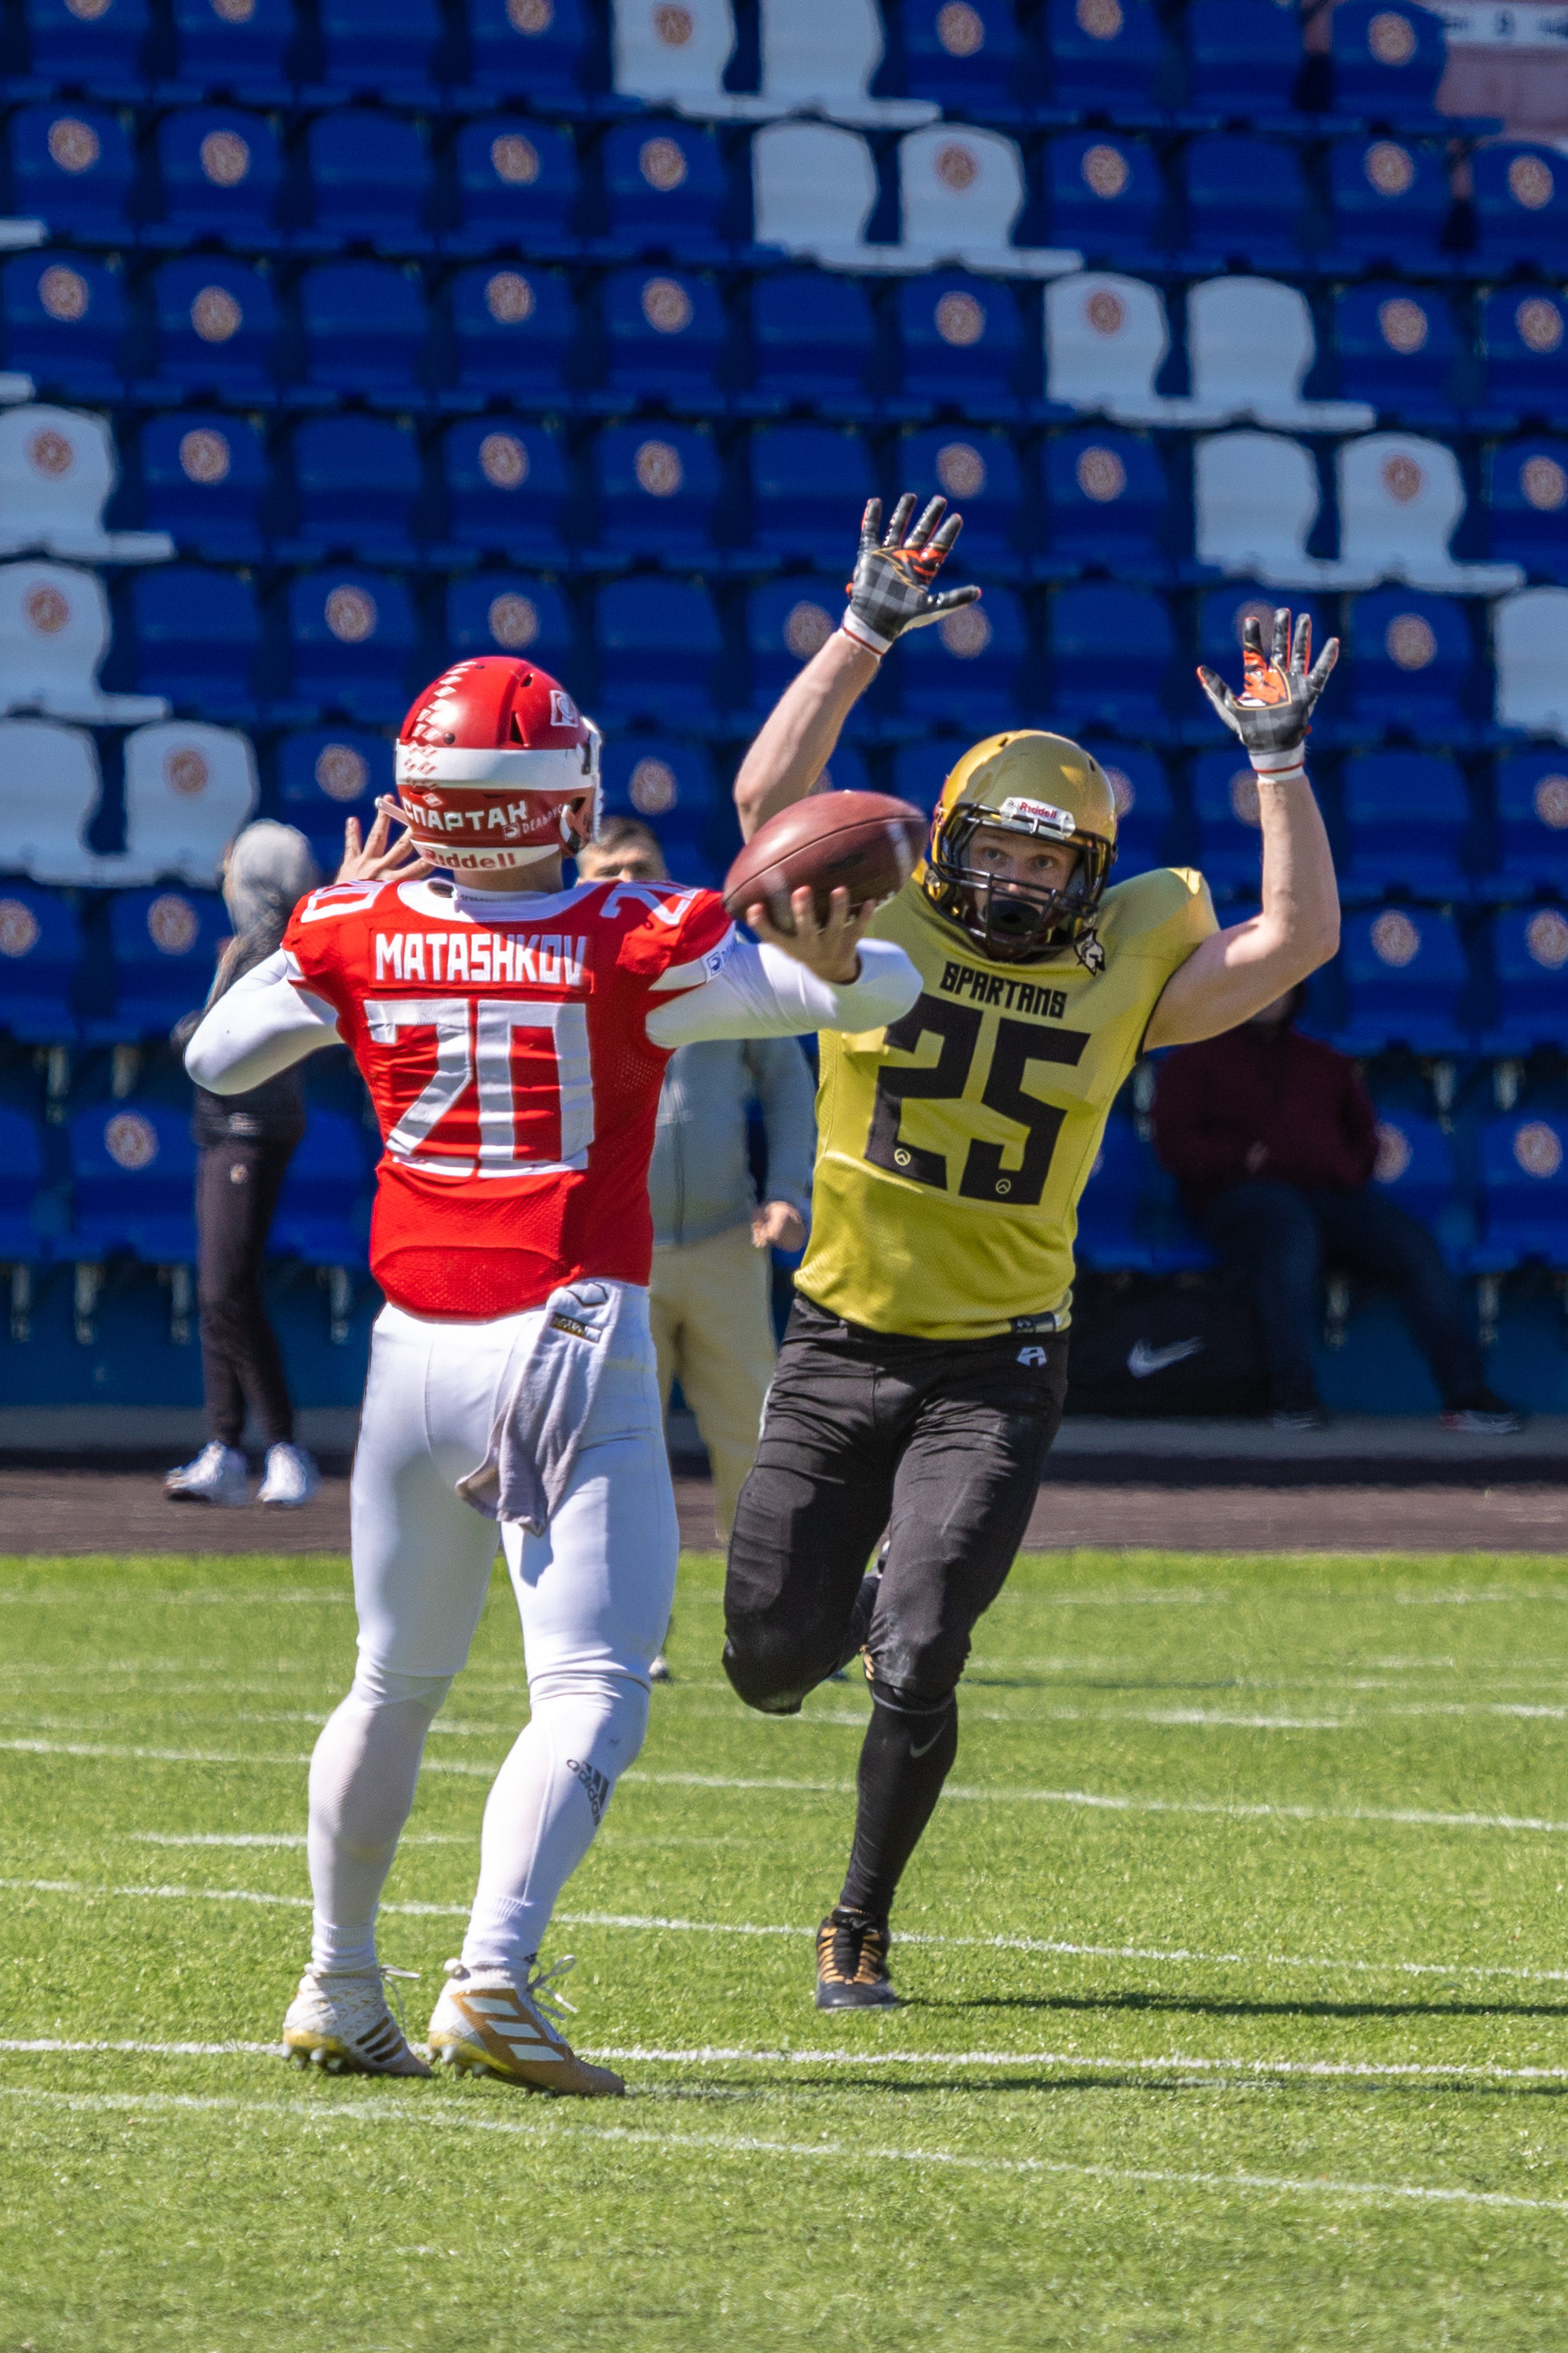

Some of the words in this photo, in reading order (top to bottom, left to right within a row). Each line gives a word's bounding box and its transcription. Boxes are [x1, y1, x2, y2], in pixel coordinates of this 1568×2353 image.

[1019, 802, 1058, 819] Riddell
[376, 933, 588, 987] MATASHKOV
[939, 961, 1067, 1020] SPARTANS
[363, 998, 595, 1178] 20
[863, 992, 1092, 1206] 25
